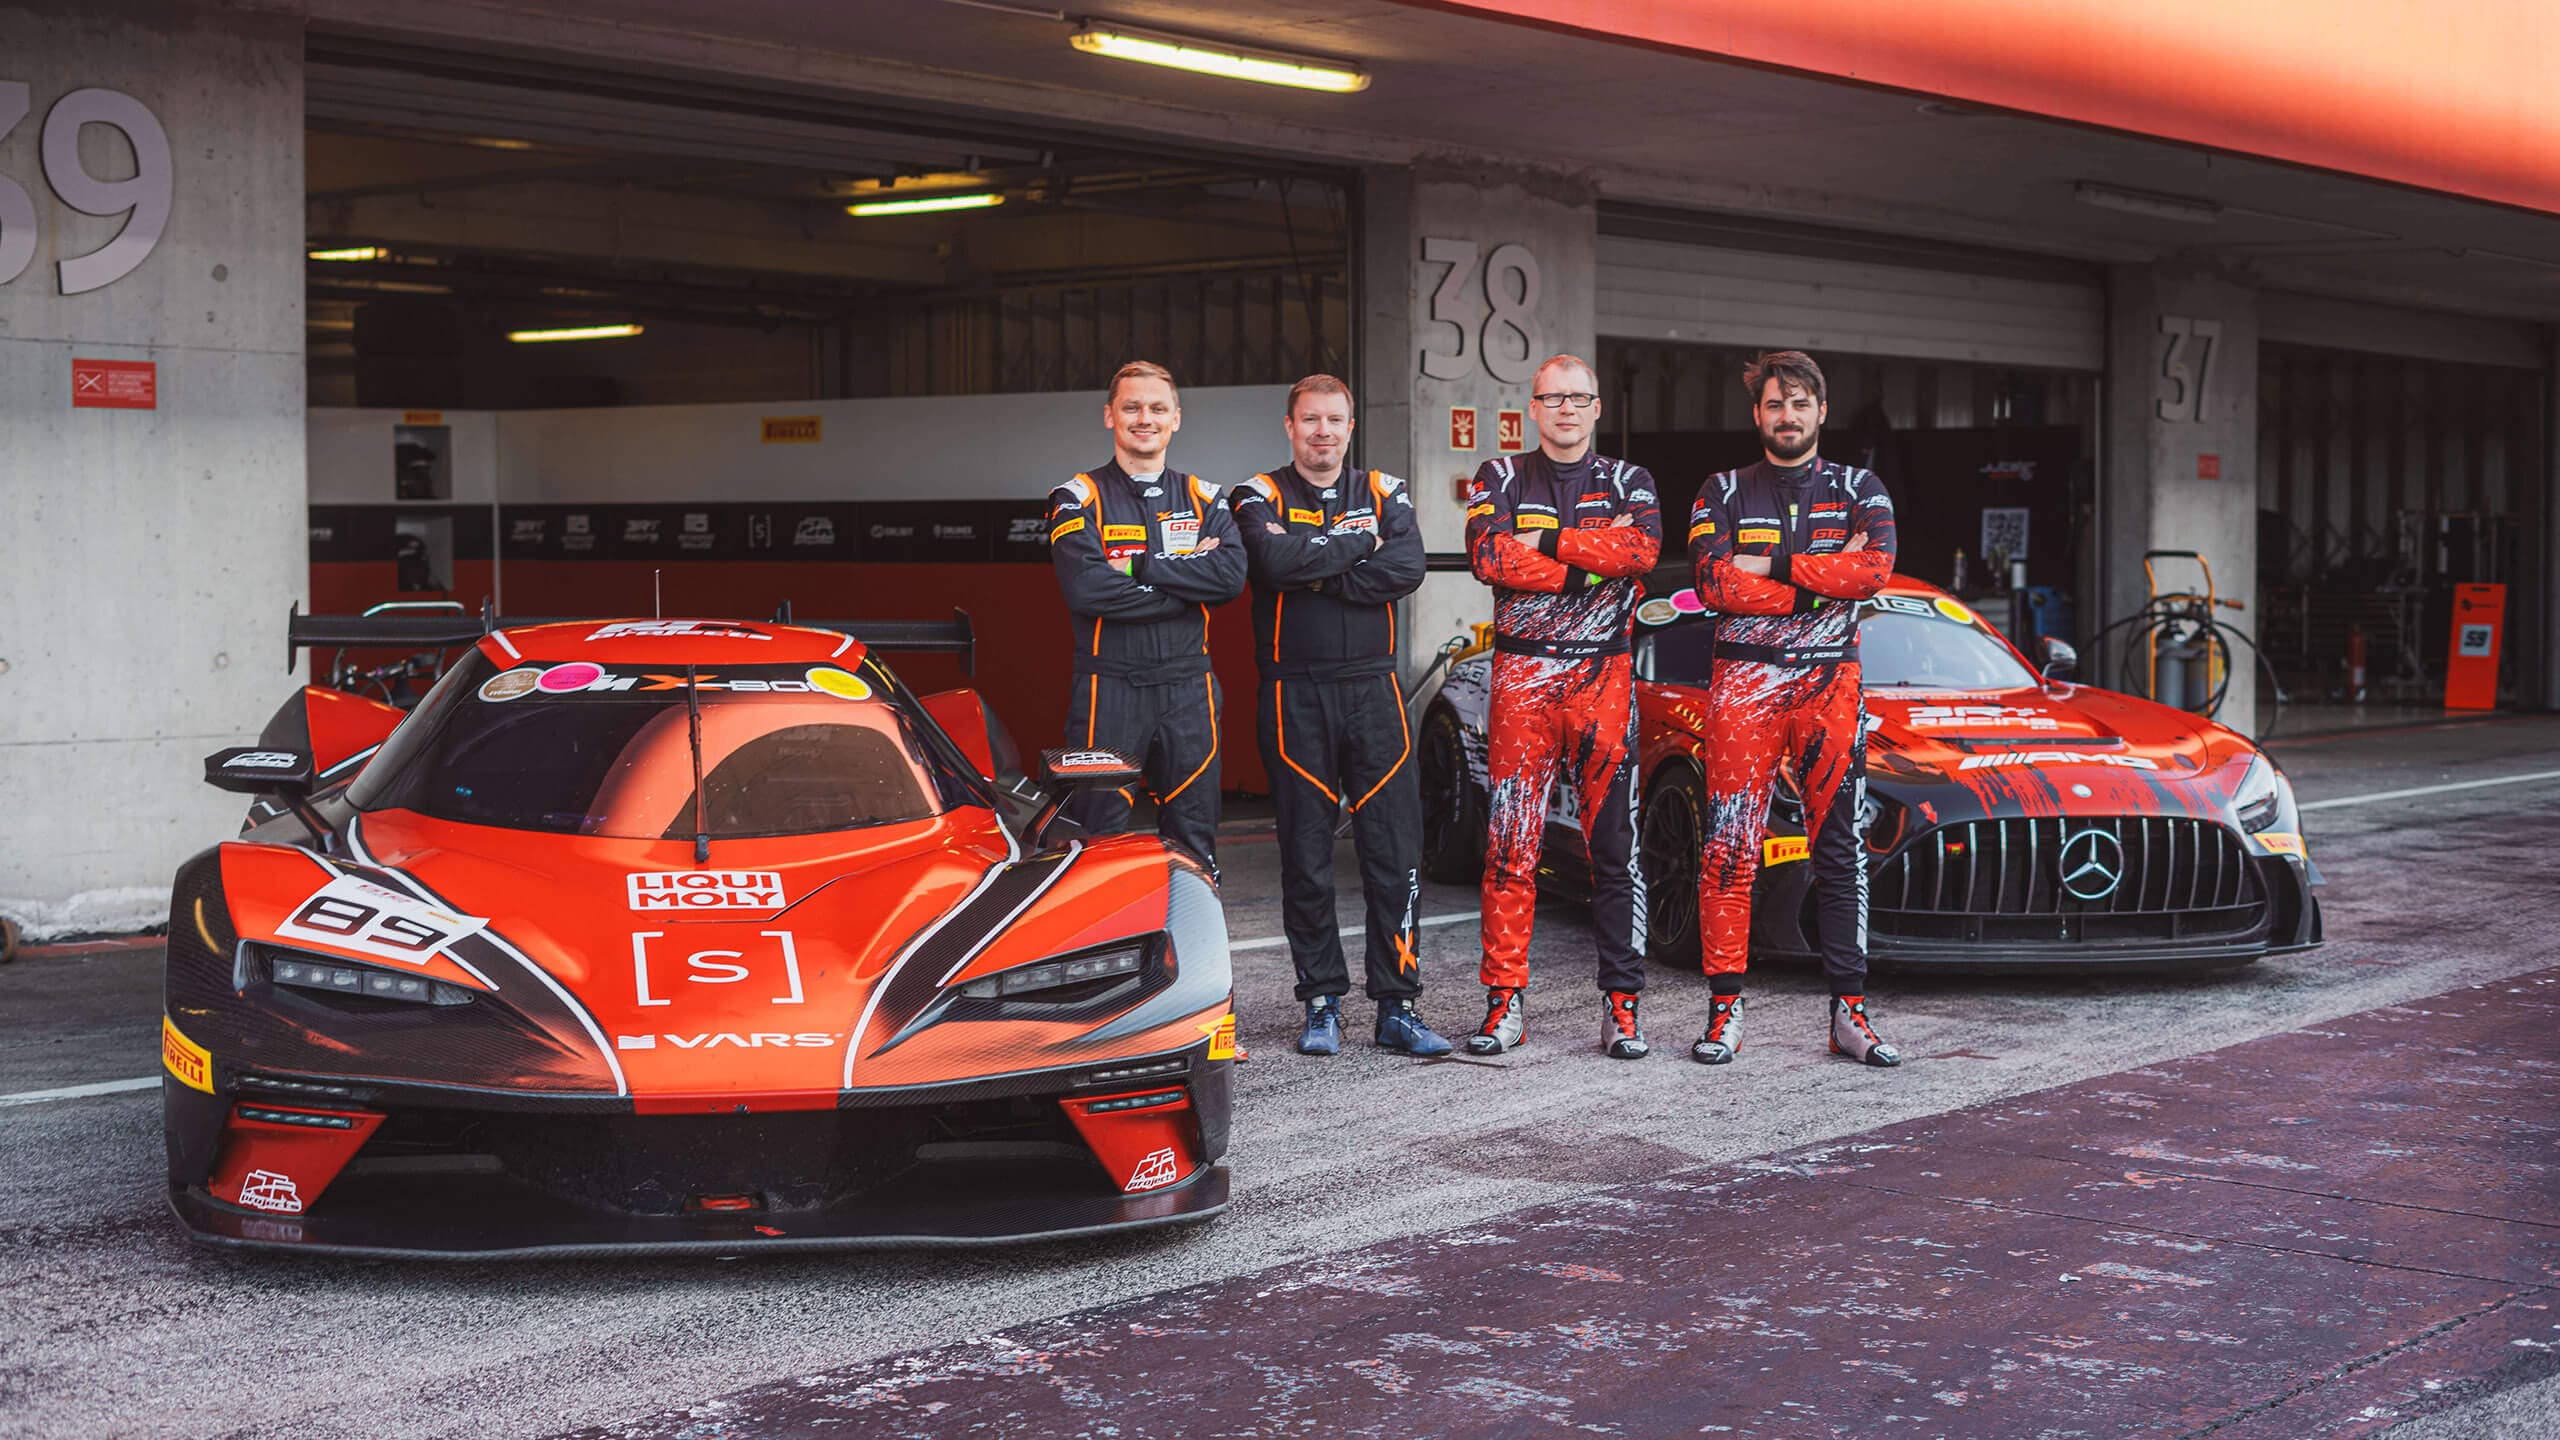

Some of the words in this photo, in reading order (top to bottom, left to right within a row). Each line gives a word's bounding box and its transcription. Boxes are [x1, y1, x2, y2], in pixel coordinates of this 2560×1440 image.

[1420, 237, 1544, 384] 38
[2156, 314, 2222, 424] 37
[1169, 521, 1199, 531] GT2
[1811, 528, 1848, 540] GT2
[2023, 751, 2160, 770] AMG
[636, 873, 774, 890] LIQUI
[638, 891, 780, 907] MOLY
[291, 896, 449, 951] 89
[663, 1033, 836, 1048] VARS
[163, 1027, 204, 1085] PIRELLI
